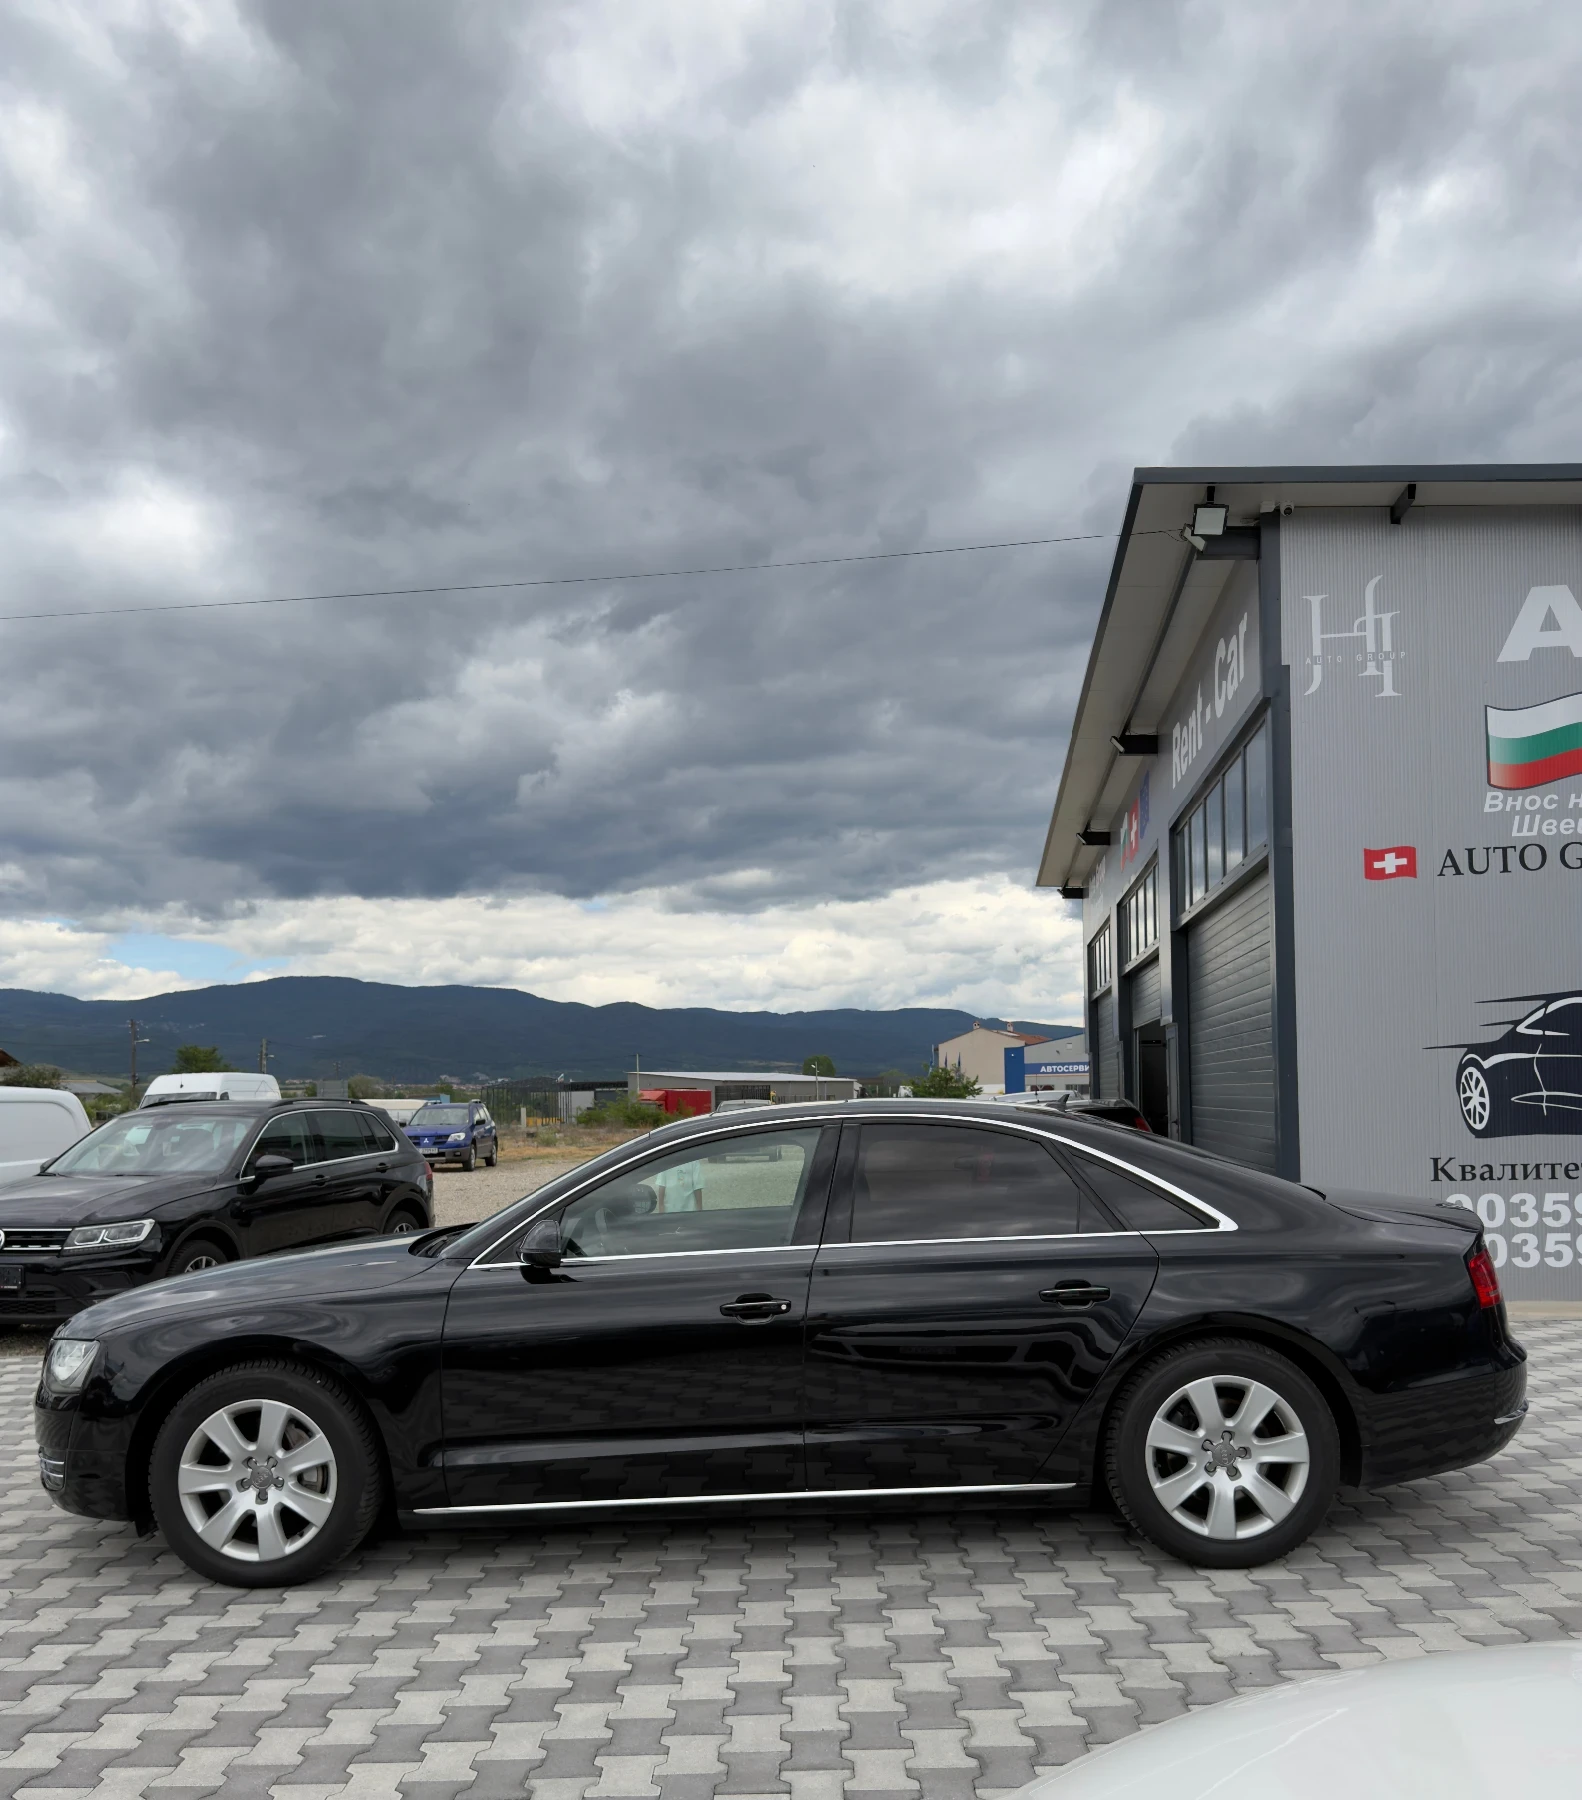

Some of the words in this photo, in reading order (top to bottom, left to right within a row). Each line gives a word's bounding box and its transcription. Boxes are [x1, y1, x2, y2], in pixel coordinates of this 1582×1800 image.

[1306, 655, 1342, 665] AUTO
[1356, 651, 1406, 662] GROUP
[1172, 681, 1203, 790] Rent
[1214, 611, 1248, 718] Car
[1483, 791, 1559, 812] Внос
[1437, 843, 1547, 876] AUTO
[1429, 1157, 1582, 1182] Квалите
